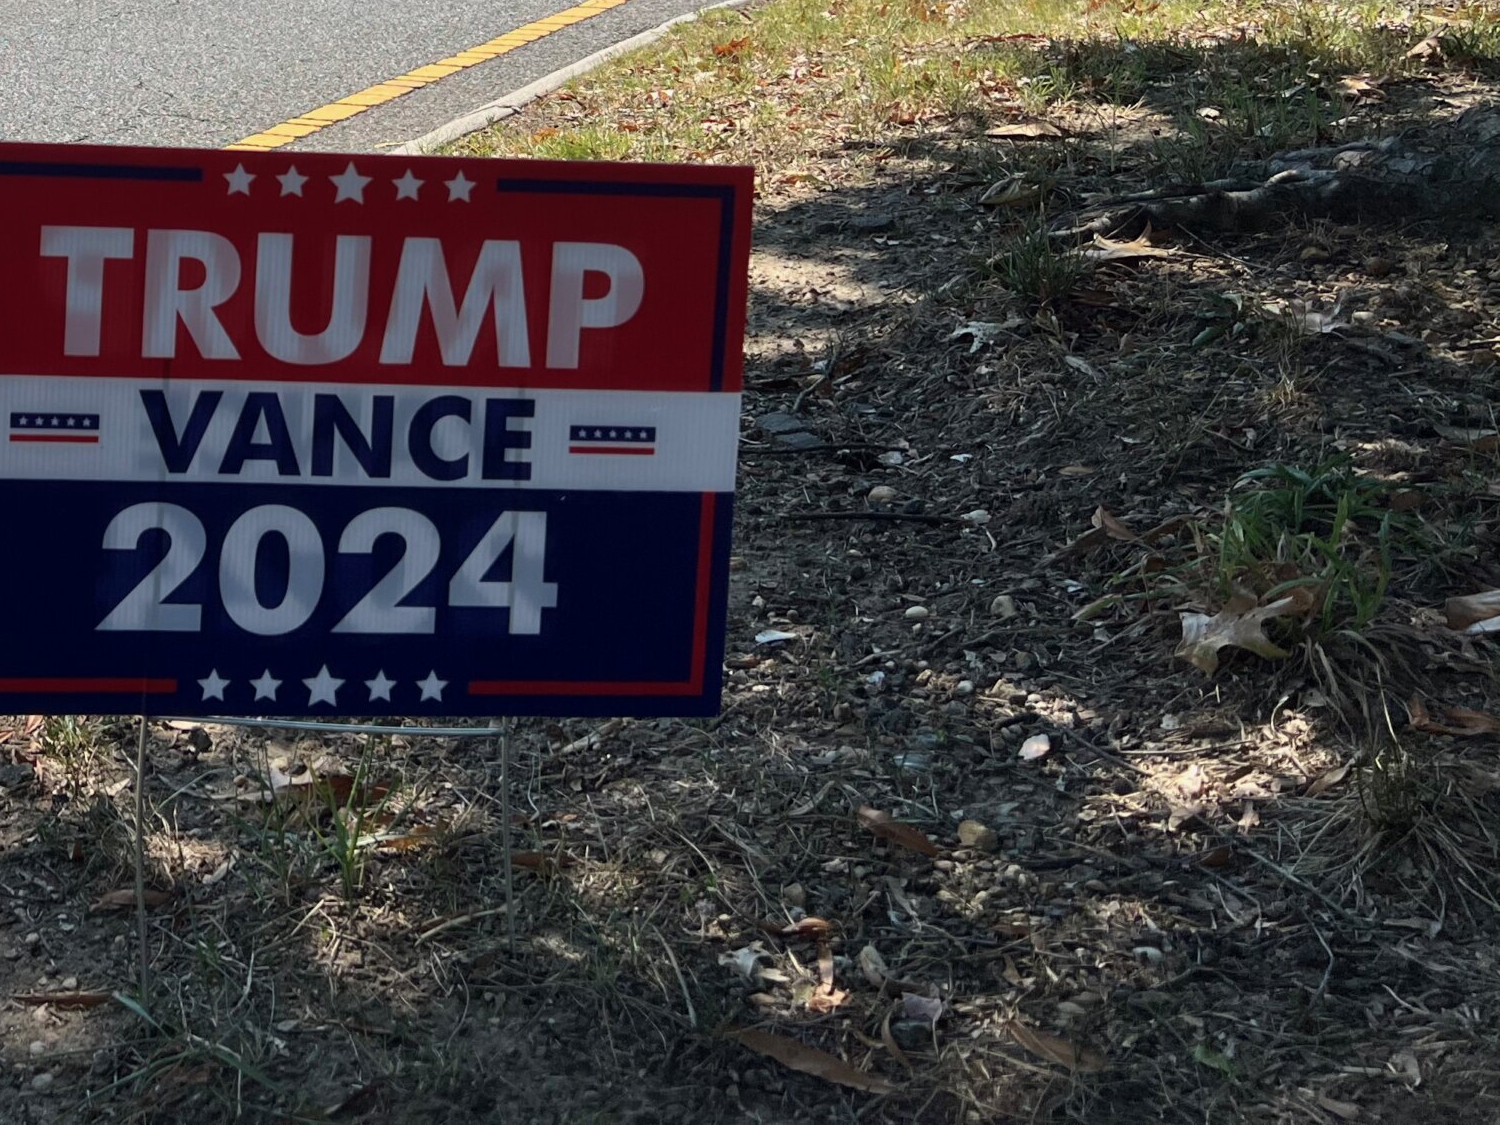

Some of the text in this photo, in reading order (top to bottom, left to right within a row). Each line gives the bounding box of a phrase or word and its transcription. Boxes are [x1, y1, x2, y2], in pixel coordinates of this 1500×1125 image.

[39, 225, 646, 369] TRUMP
[138, 389, 536, 481] VANCE
[94, 501, 559, 636] 2024
